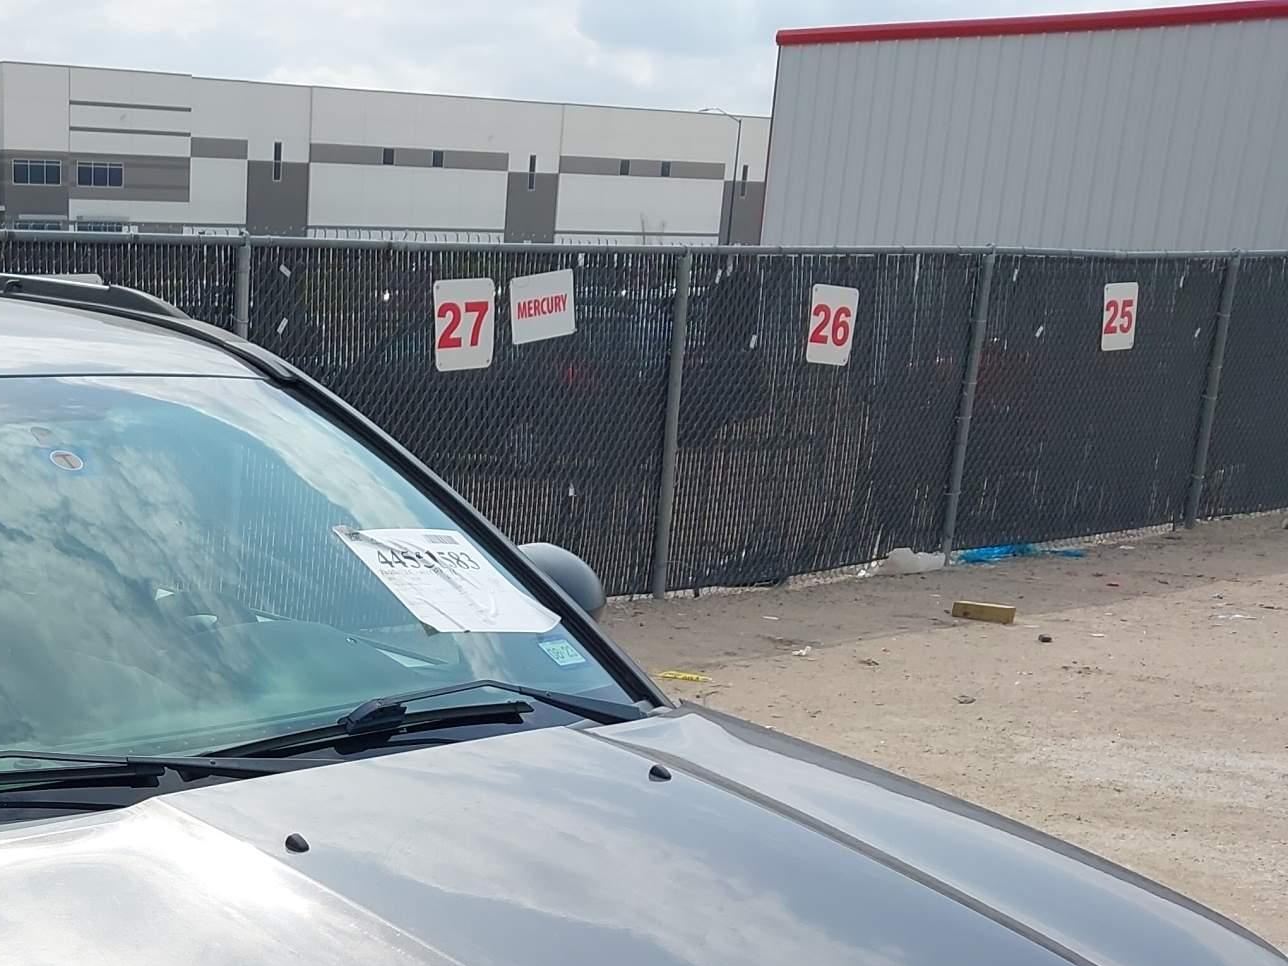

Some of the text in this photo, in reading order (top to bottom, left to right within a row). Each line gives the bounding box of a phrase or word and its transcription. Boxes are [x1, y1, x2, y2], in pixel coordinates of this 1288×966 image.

[437, 301, 489, 349] 27
[517, 293, 568, 320] MERCURY
[809, 303, 852, 347] 26
[1103, 299, 1134, 335] 25
